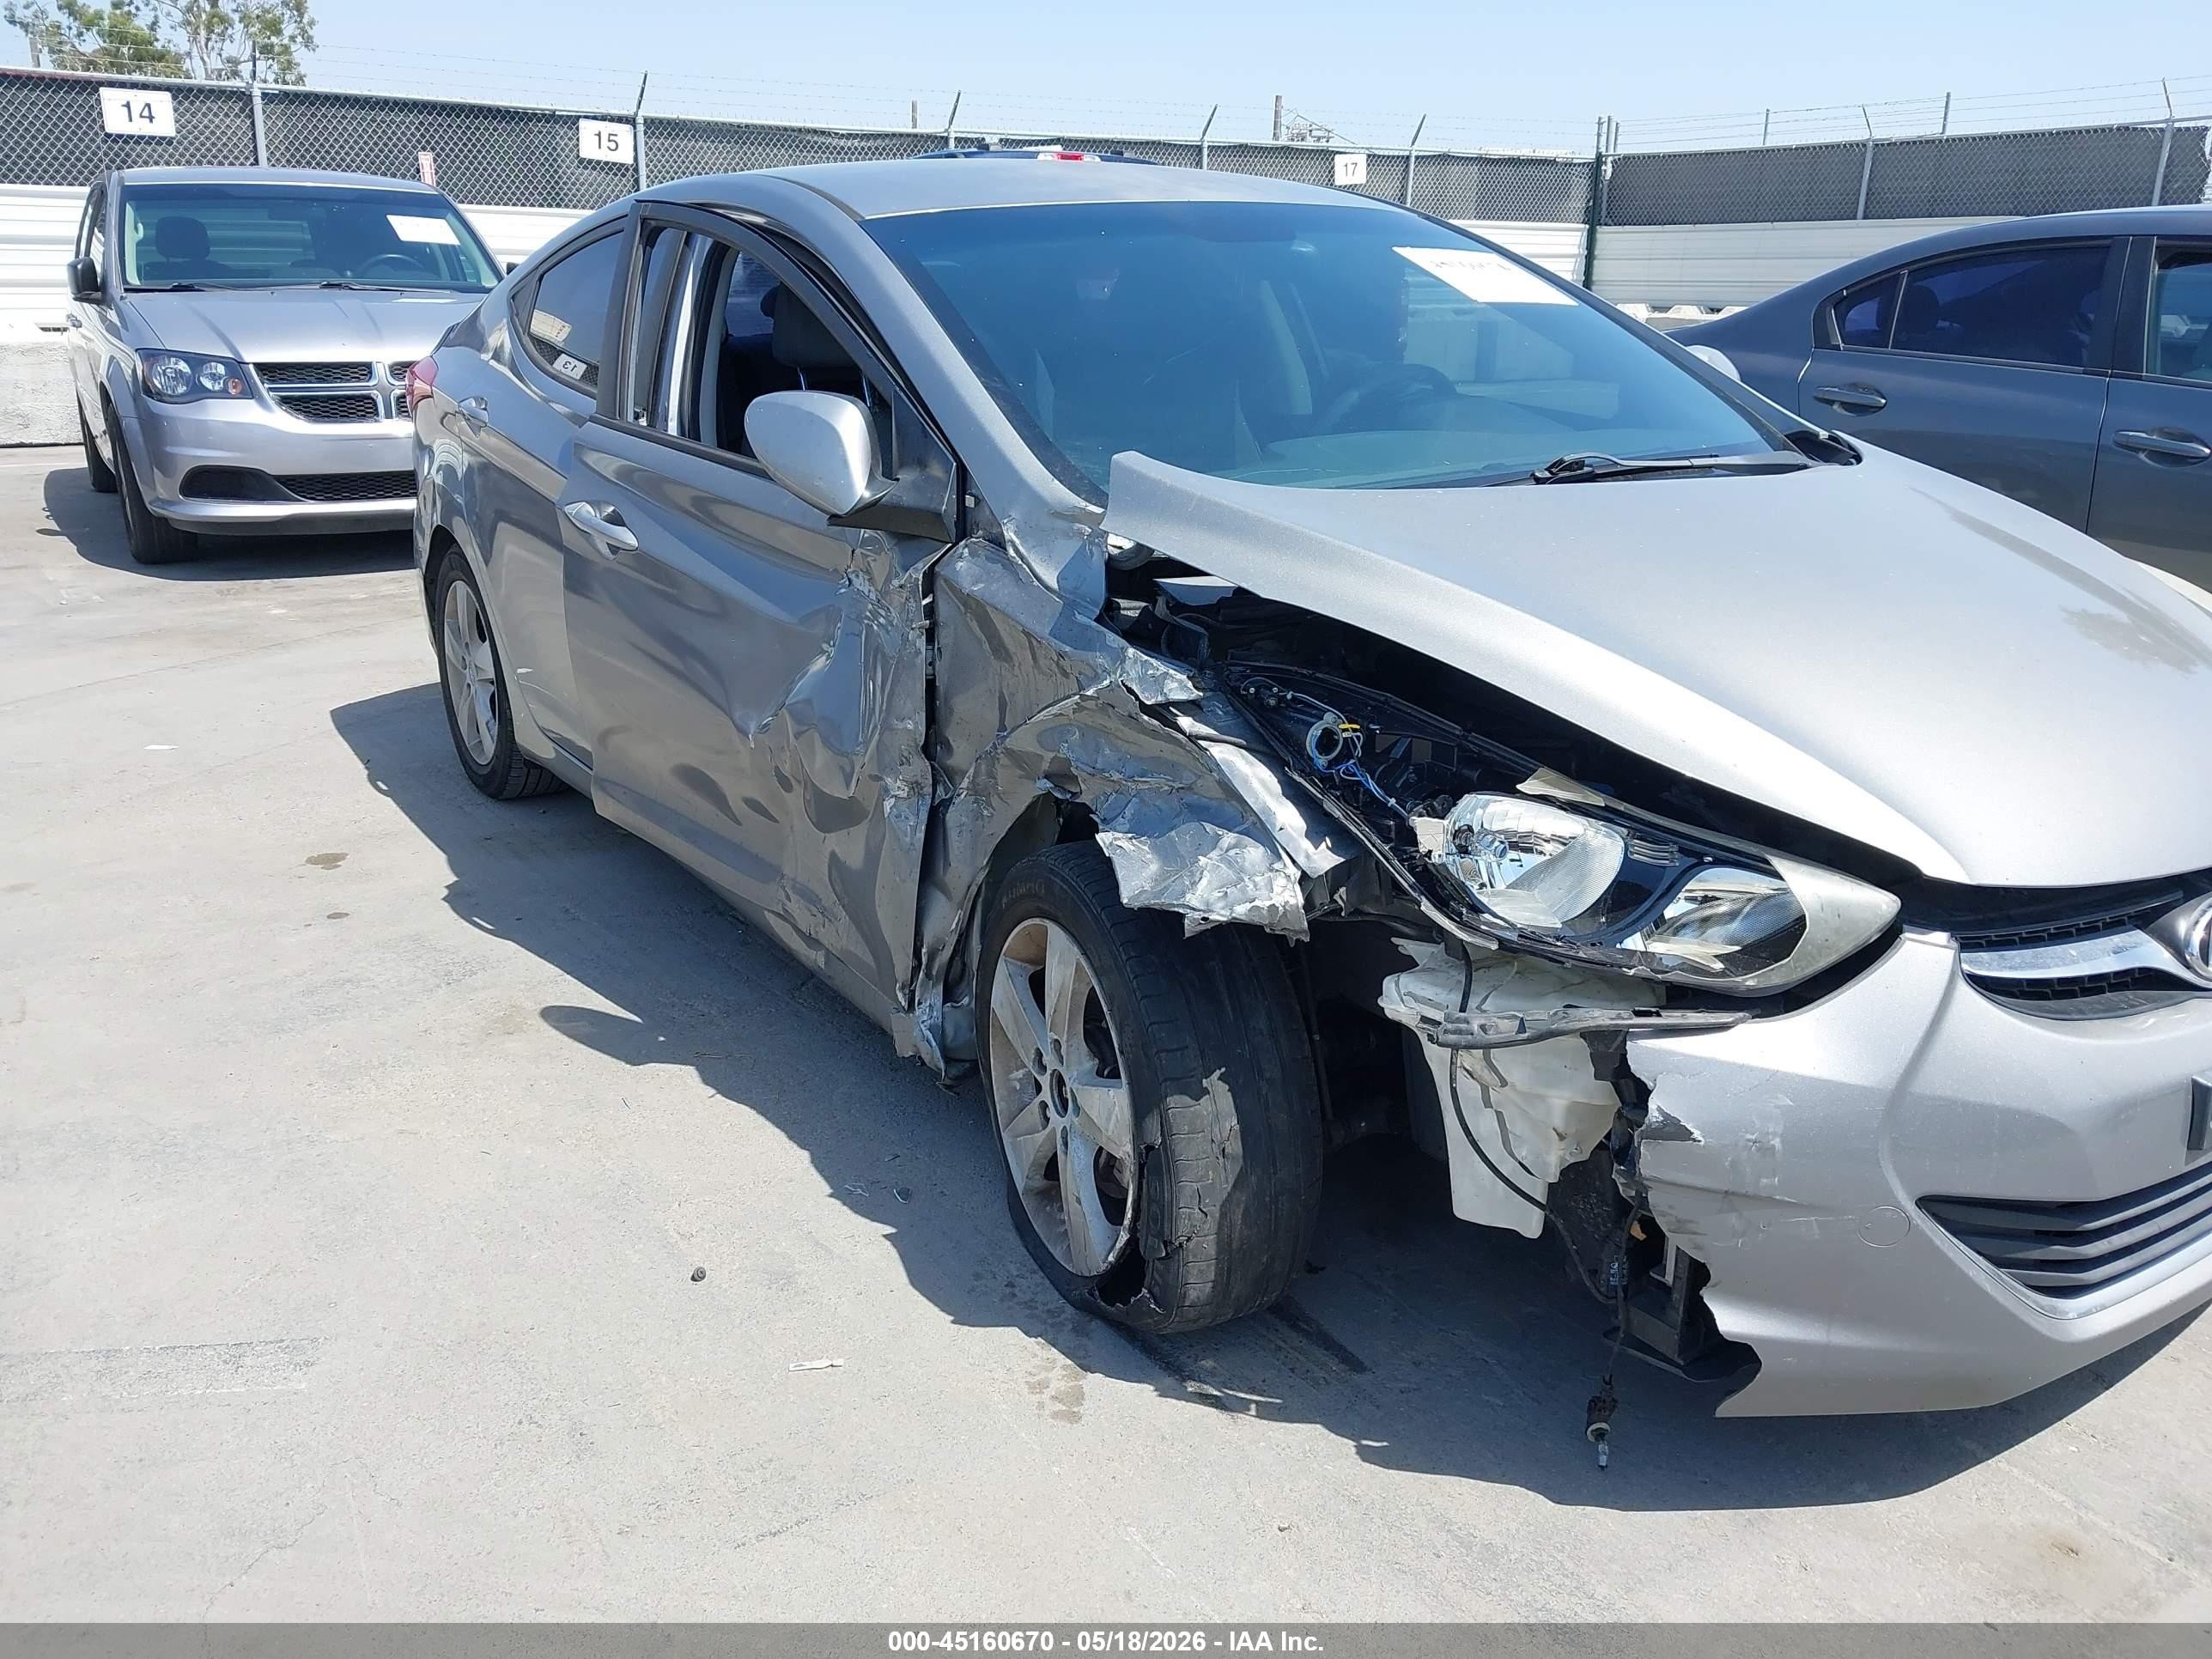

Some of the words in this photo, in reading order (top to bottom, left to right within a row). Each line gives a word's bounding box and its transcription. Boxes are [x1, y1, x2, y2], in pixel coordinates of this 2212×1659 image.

[121, 100, 155, 124] 14
[593, 130, 619, 151] 15
[1344, 162, 1358, 177] 17
